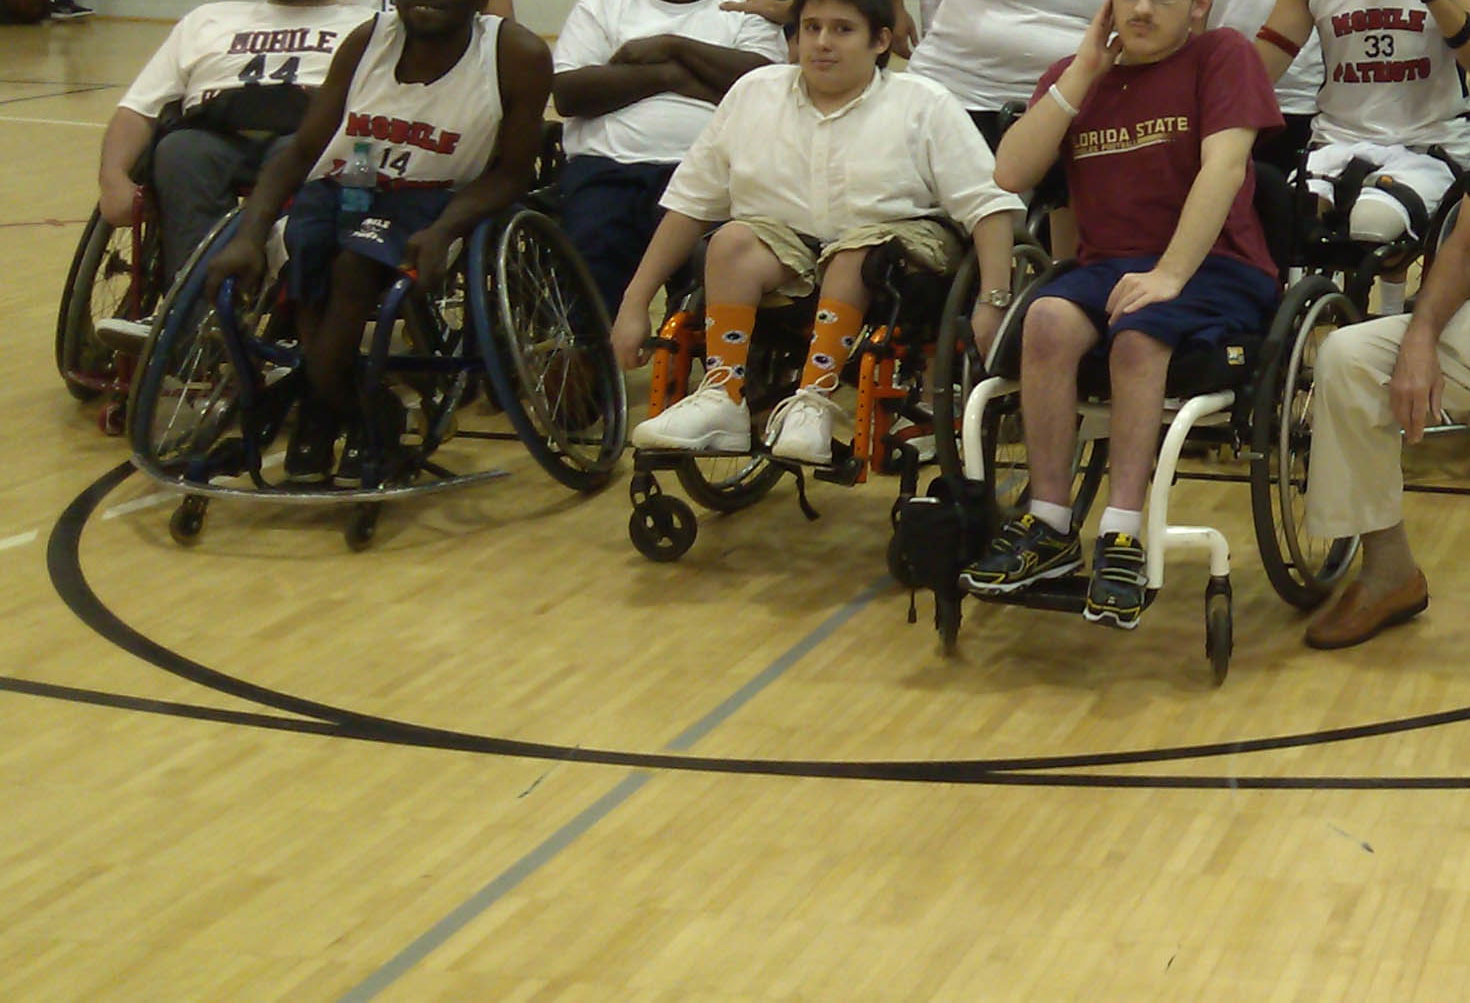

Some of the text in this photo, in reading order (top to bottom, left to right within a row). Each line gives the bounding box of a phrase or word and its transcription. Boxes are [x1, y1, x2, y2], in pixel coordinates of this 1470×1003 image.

[1331, 7, 1428, 38] MOBILE
[227, 28, 338, 55] MOBILE
[1364, 34, 1395, 58] 33
[238, 53, 301, 86] 44
[1333, 56, 1431, 84] PATRIOTS
[345, 111, 462, 156] MOBILE
[1136, 117, 1189, 137] STATE
[378, 147, 412, 176] 14
